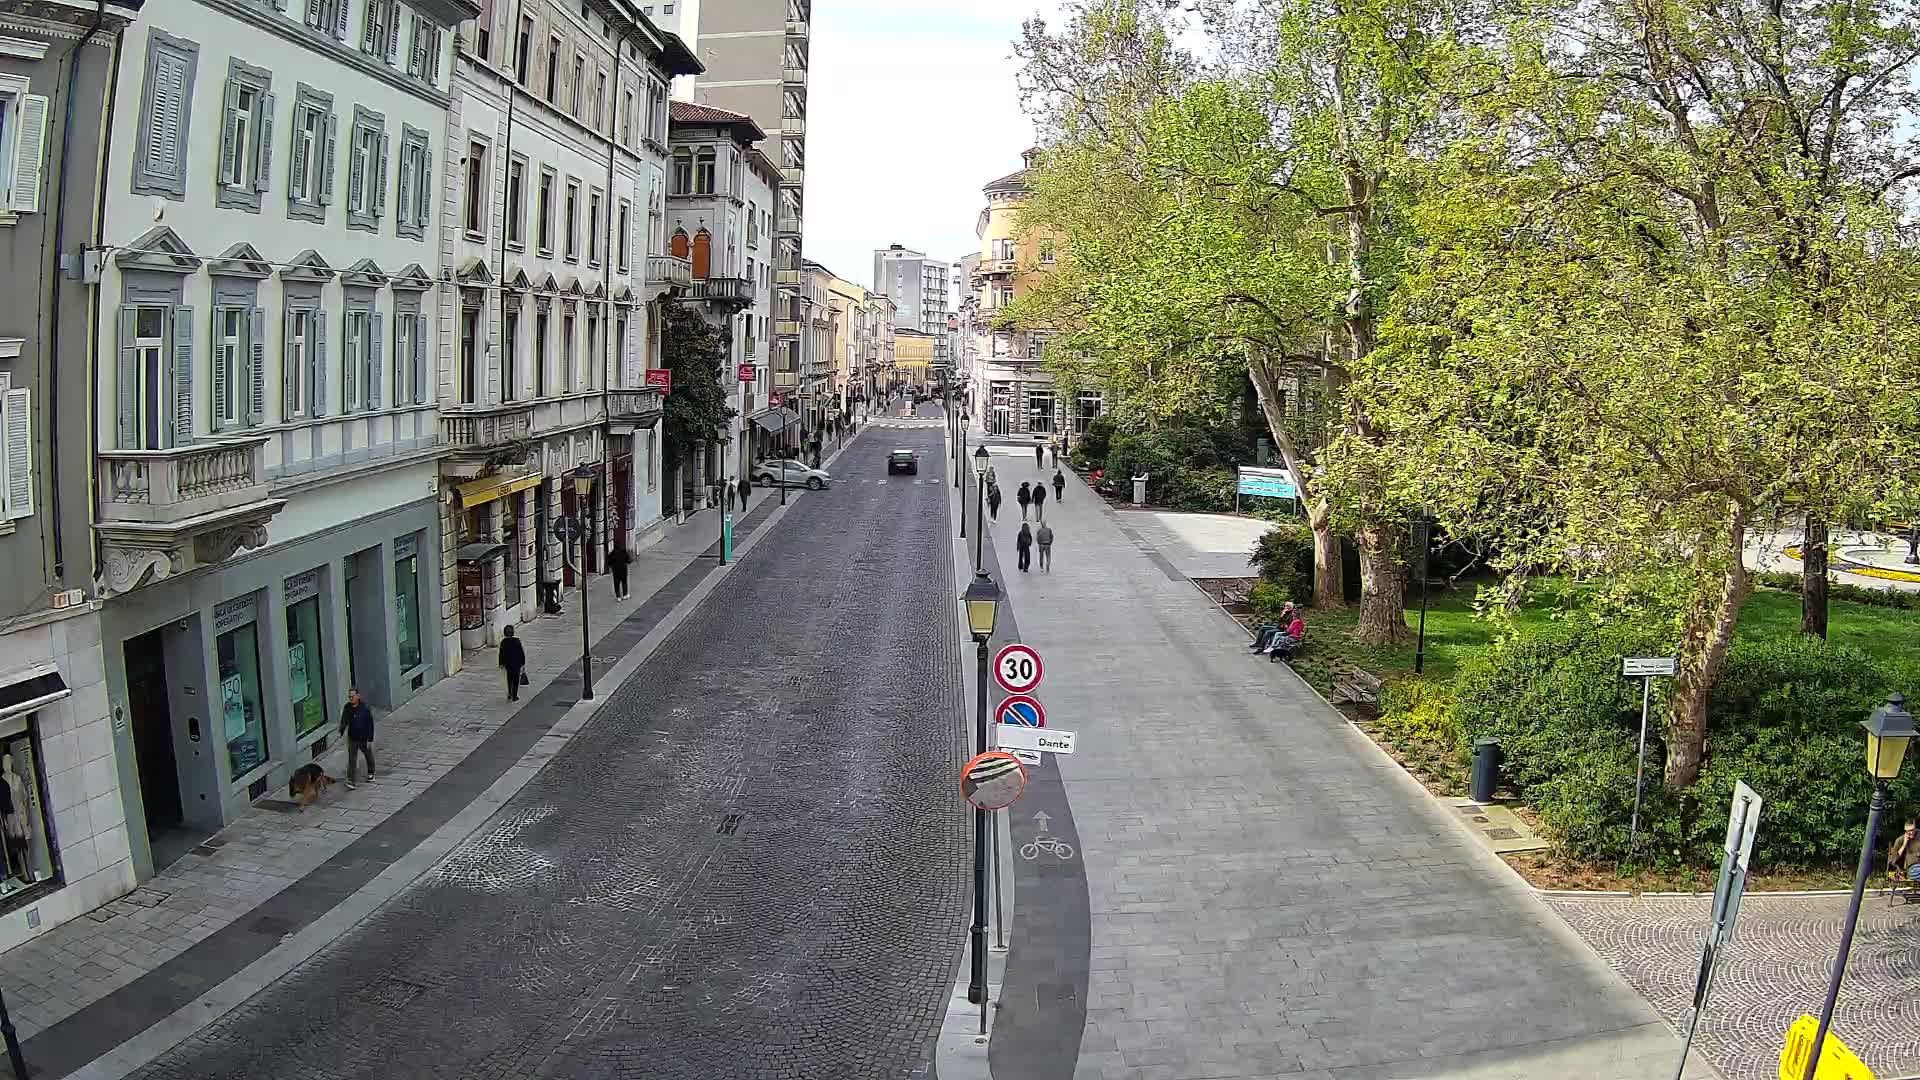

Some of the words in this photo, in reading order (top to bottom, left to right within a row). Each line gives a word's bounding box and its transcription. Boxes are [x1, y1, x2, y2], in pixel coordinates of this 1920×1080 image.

[1005, 658, 1033, 680] 30
[222, 678, 240, 700] 130
[1039, 738, 1070, 749] Dante
